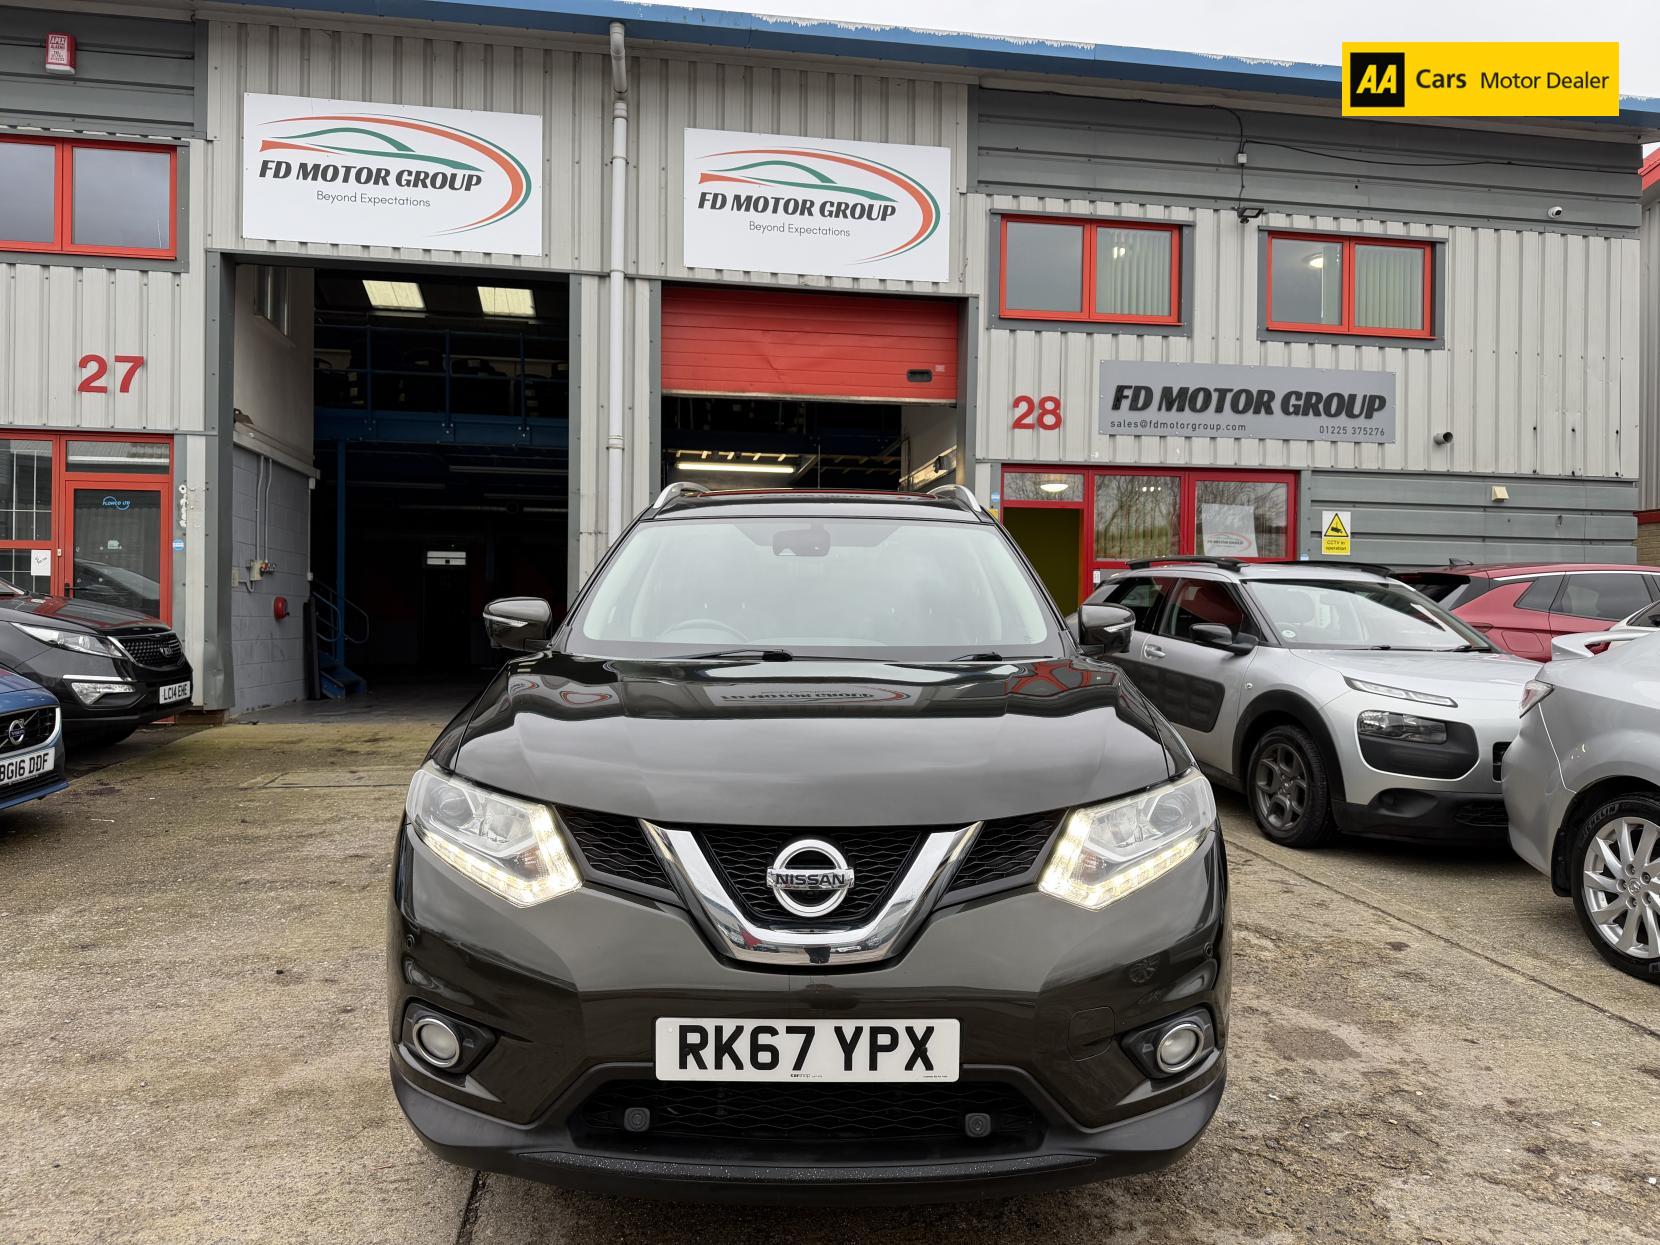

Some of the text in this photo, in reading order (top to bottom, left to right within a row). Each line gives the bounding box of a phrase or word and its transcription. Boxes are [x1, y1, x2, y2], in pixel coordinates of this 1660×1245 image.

[259, 160, 482, 192] FD MOTOR GROUP
[316, 190, 431, 207] Beyond Expectations
[698, 192, 896, 221] FD MOTOR GROUP
[749, 221, 850, 237] Beyond Expectations
[78, 354, 144, 393] 27
[1012, 395, 1062, 430] 28
[1111, 384, 1387, 419] FD MOTOR GROUP
[1110, 419, 1247, 432] sales@fdmotorgroup.com
[1319, 425, 1385, 437] 01225 375276
[163, 686, 177, 700] LC14
[28, 752, 49, 774] DDF
[775, 873, 845, 886] NISSAN
[678, 1025, 935, 1072] RK67 YPX
